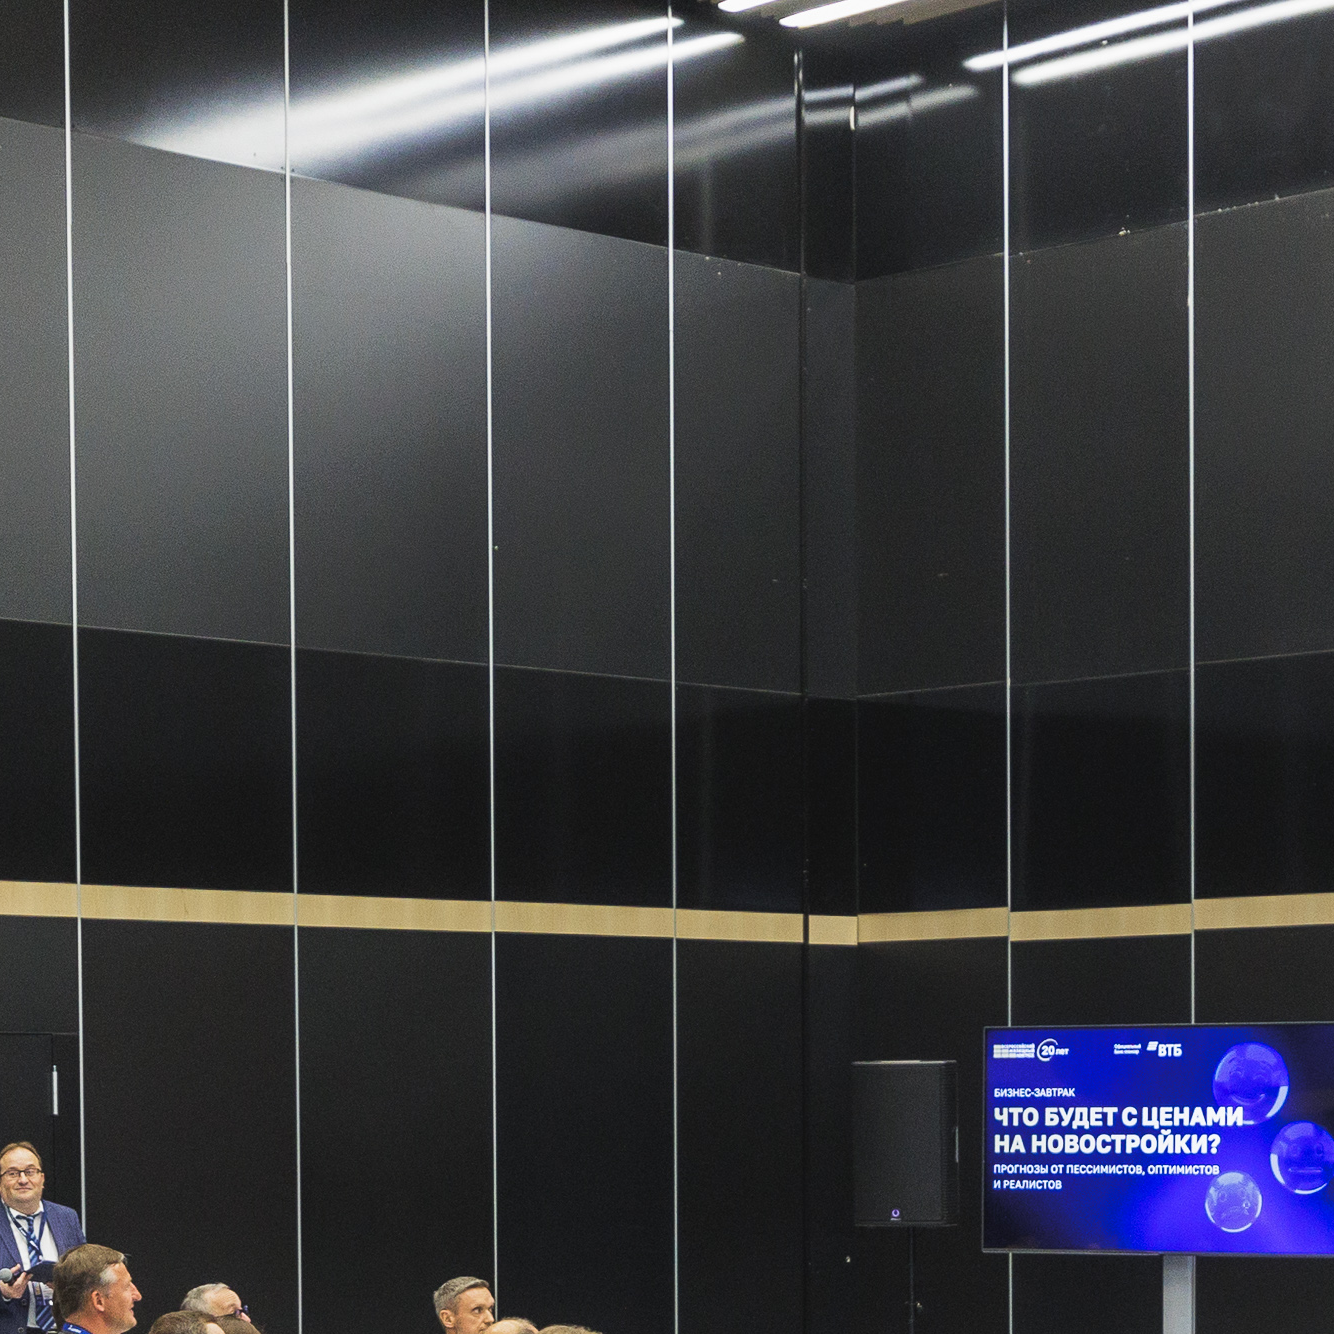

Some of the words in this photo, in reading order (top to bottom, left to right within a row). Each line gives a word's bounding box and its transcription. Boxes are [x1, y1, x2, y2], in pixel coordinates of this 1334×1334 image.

[1041, 1045, 1055, 1055] 20
[1158, 1044, 1182, 1057] ВТБ
[994, 1088, 1075, 1098] БИЗНЕС-ЗАВТРАК
[994, 1107, 1039, 1126] ЧТО
[1045, 1107, 1117, 1129] БУДЕТ
[1121, 1107, 1137, 1126] С
[1142, 1106, 1243, 1129] ЦЕНАМИ
[994, 1134, 1026, 1154] НА
[1031, 1130, 1221, 1154] НОВОСТРОЙКИ?
[993, 1164, 1048, 1175] ПРОГНОЗЫ
[1051, 1164, 1065, 1174] ОТ
[1066, 1164, 1145, 1176] ПЕССИМИСТОВ,
[1148, 1164, 1220, 1175] ОПТИМИСТОВ
[993, 1180, 1001, 1189] И
[1003, 1180, 1062, 1190] РЕАЛИСТОВ
